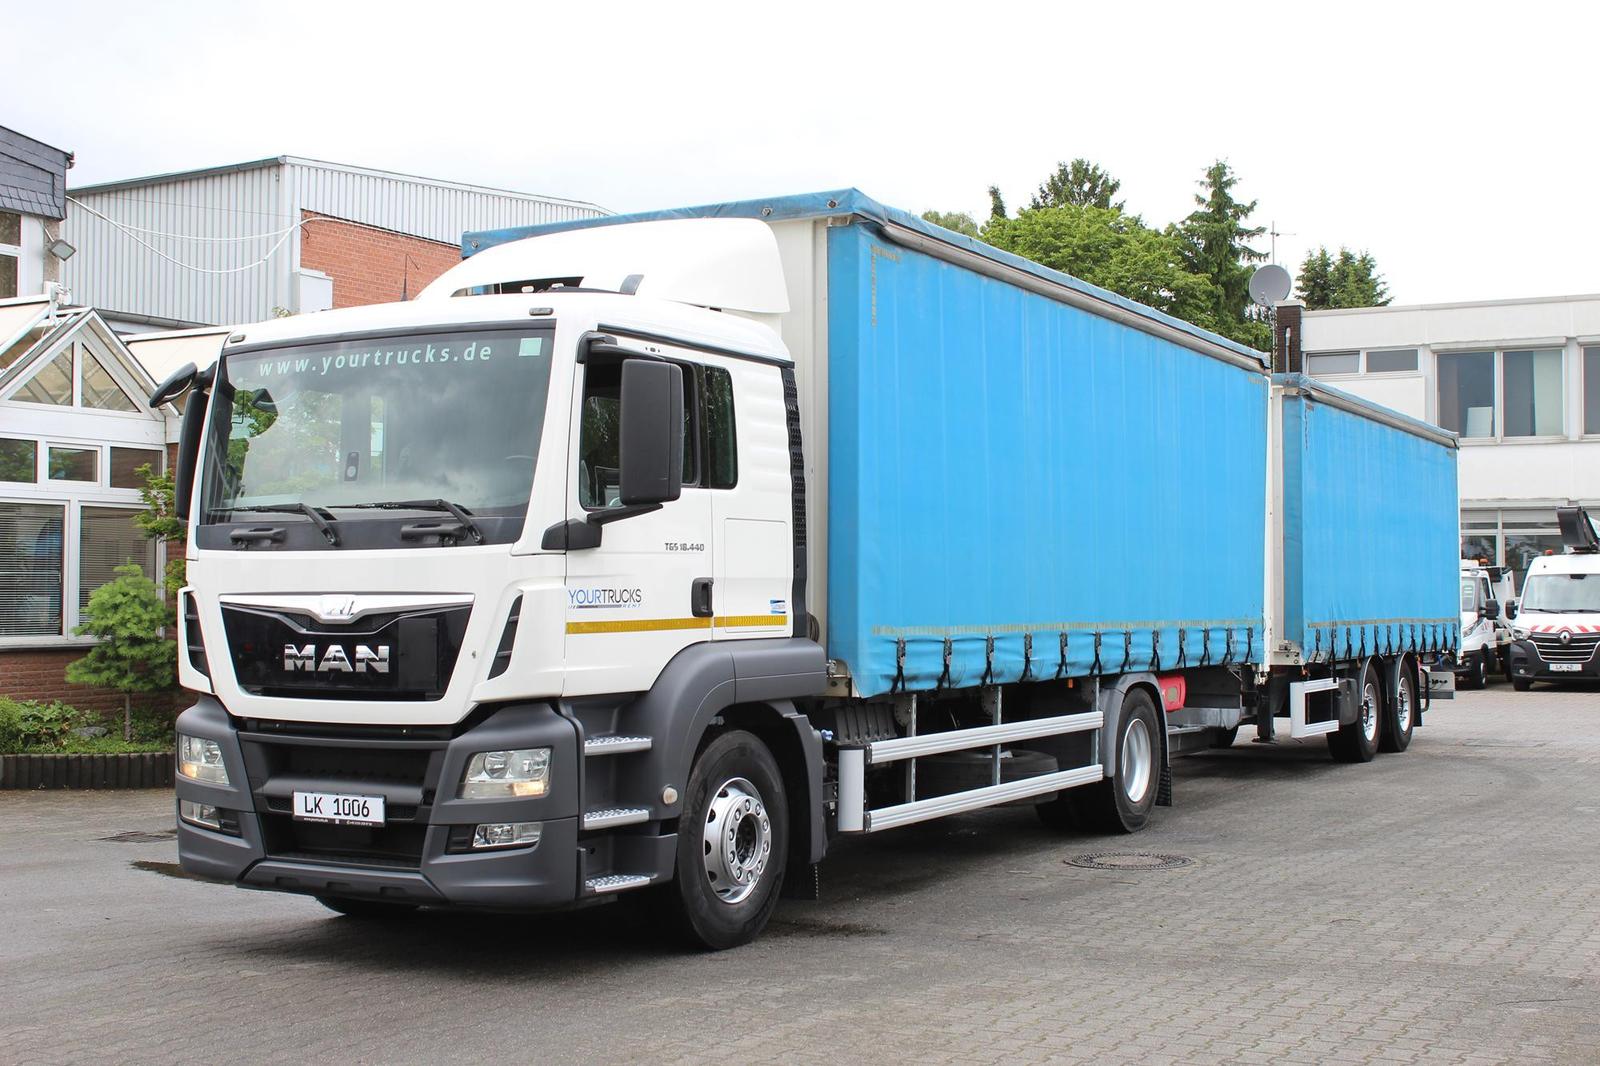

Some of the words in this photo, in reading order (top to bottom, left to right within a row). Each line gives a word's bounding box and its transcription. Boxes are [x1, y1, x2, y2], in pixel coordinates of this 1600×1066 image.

[259, 342, 492, 376] www.yourtrucks.de
[664, 542, 679, 551] TGS
[679, 543, 705, 552] 18.440
[568, 589, 642, 604] YOURTRUCKS
[284, 644, 390, 673] MAN
[304, 795, 323, 815] LK
[333, 798, 370, 818] 1006
